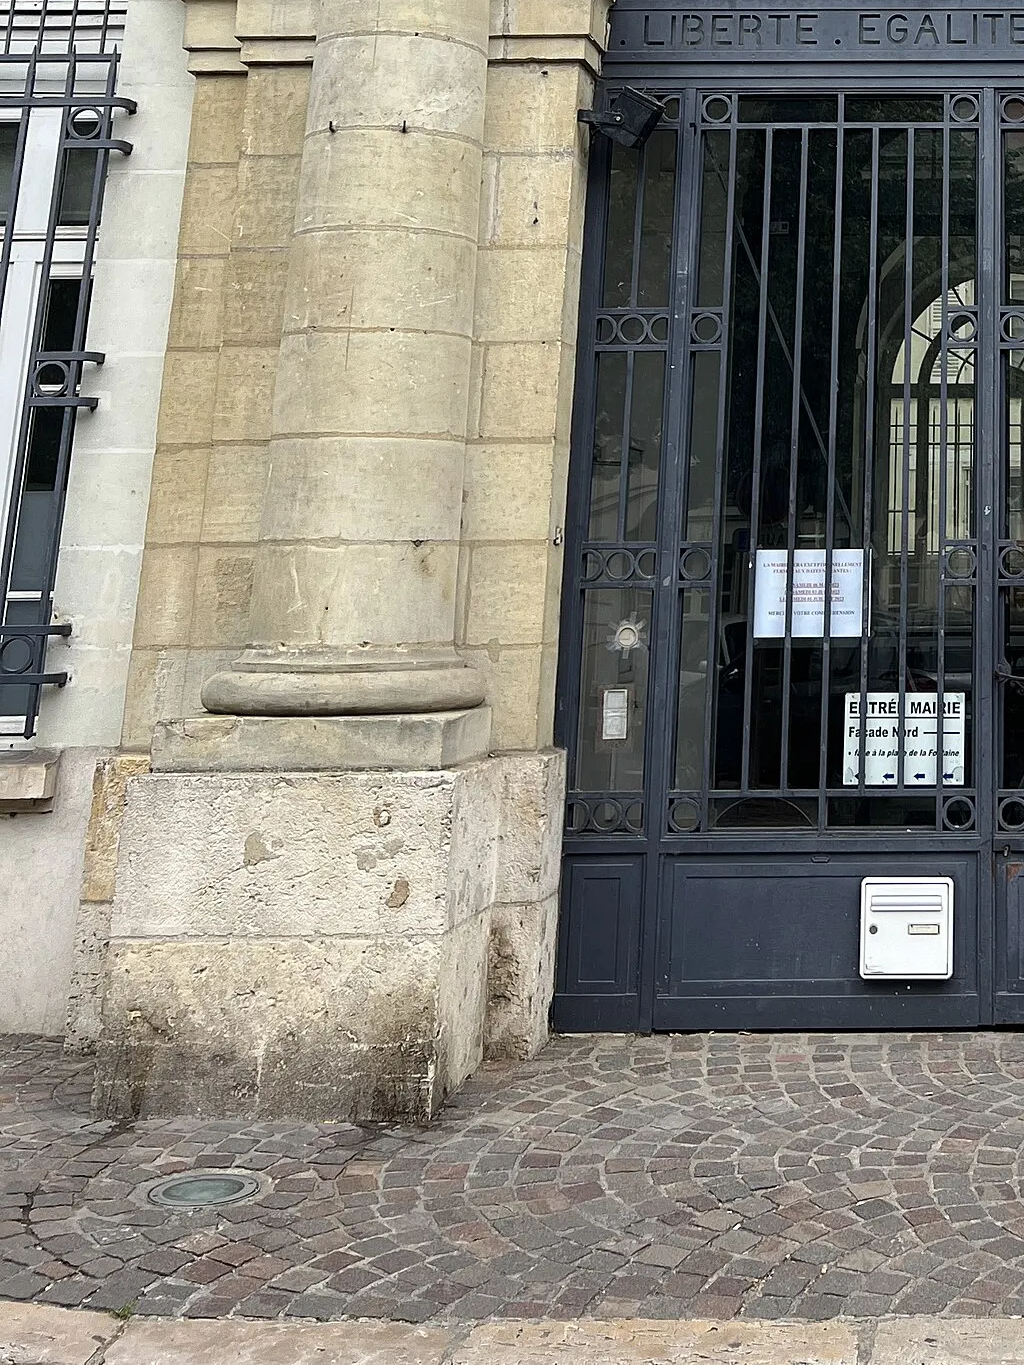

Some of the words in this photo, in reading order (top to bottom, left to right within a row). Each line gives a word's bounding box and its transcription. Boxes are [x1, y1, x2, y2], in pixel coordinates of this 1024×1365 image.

[643, 13, 819, 46] LIBERTE
[849, 698, 901, 714] ETRÉ
[886, 749, 907, 758] plae
